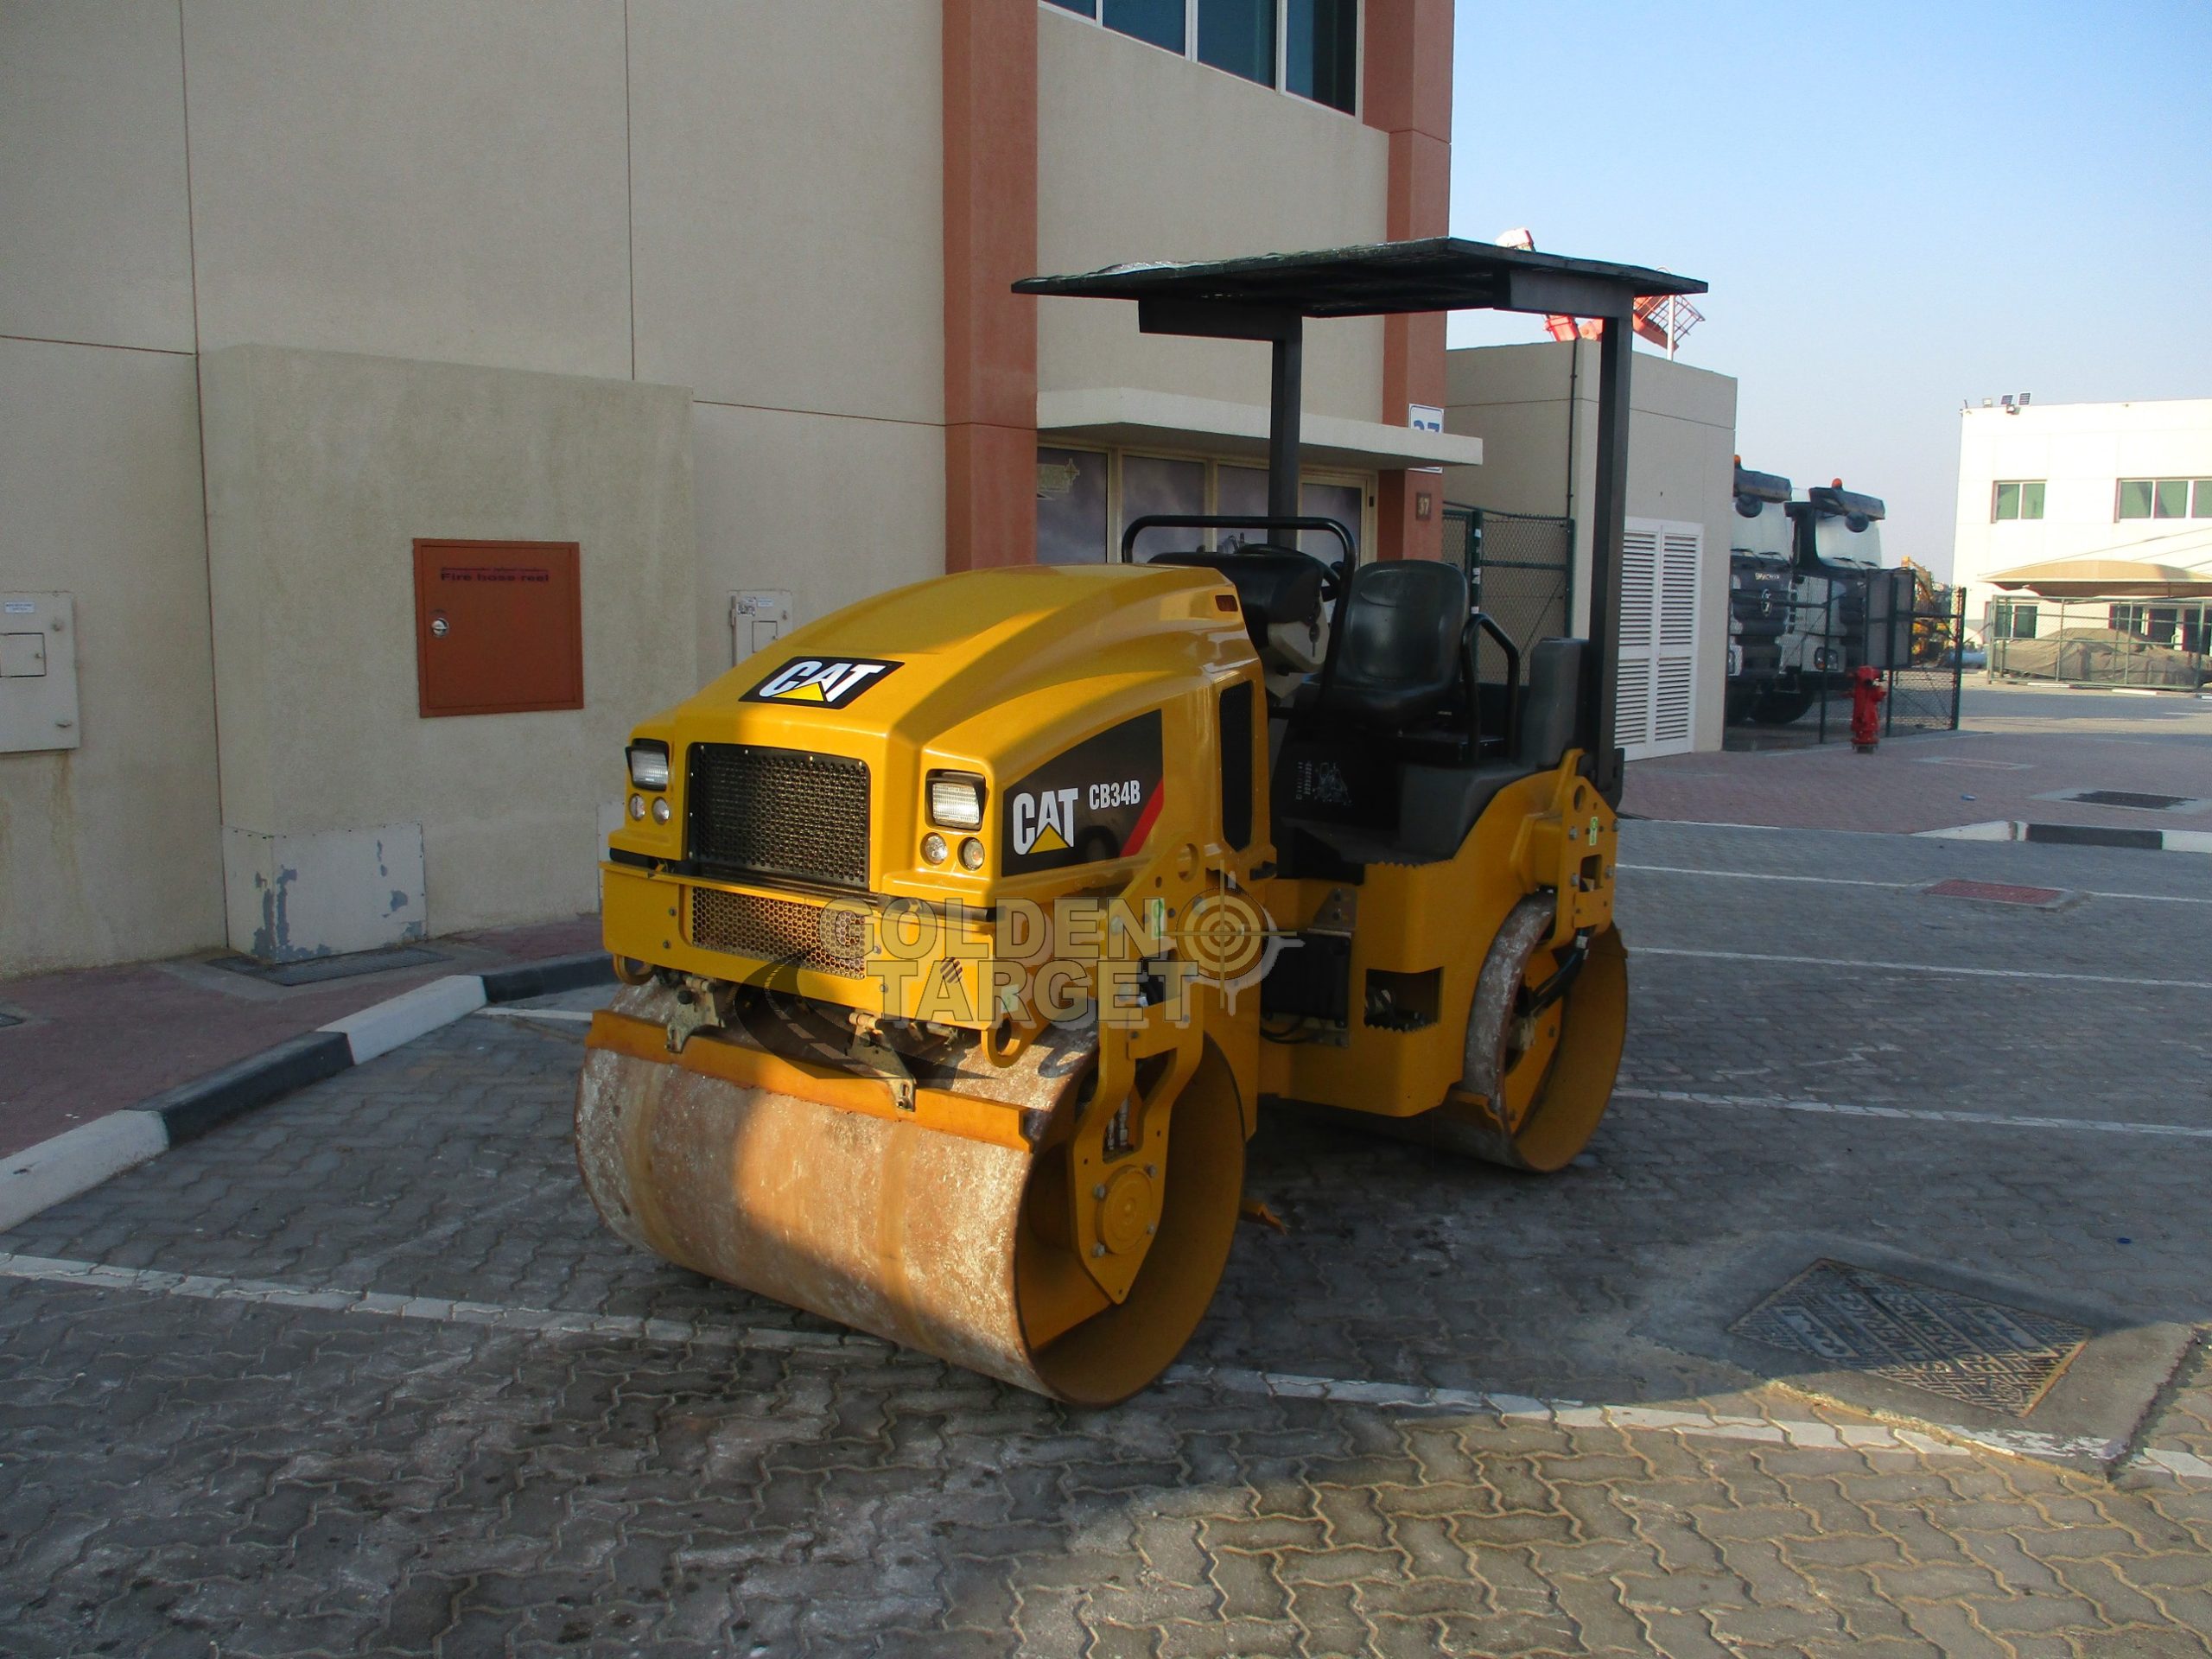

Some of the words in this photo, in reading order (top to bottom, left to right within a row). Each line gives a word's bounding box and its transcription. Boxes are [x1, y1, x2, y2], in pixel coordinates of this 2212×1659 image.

[441, 572, 472, 582] Fire
[477, 573, 516, 582] hose
[759, 660, 887, 702] CAT
[1013, 787, 1078, 855] CAT
[1089, 779, 1141, 810] CB34B
